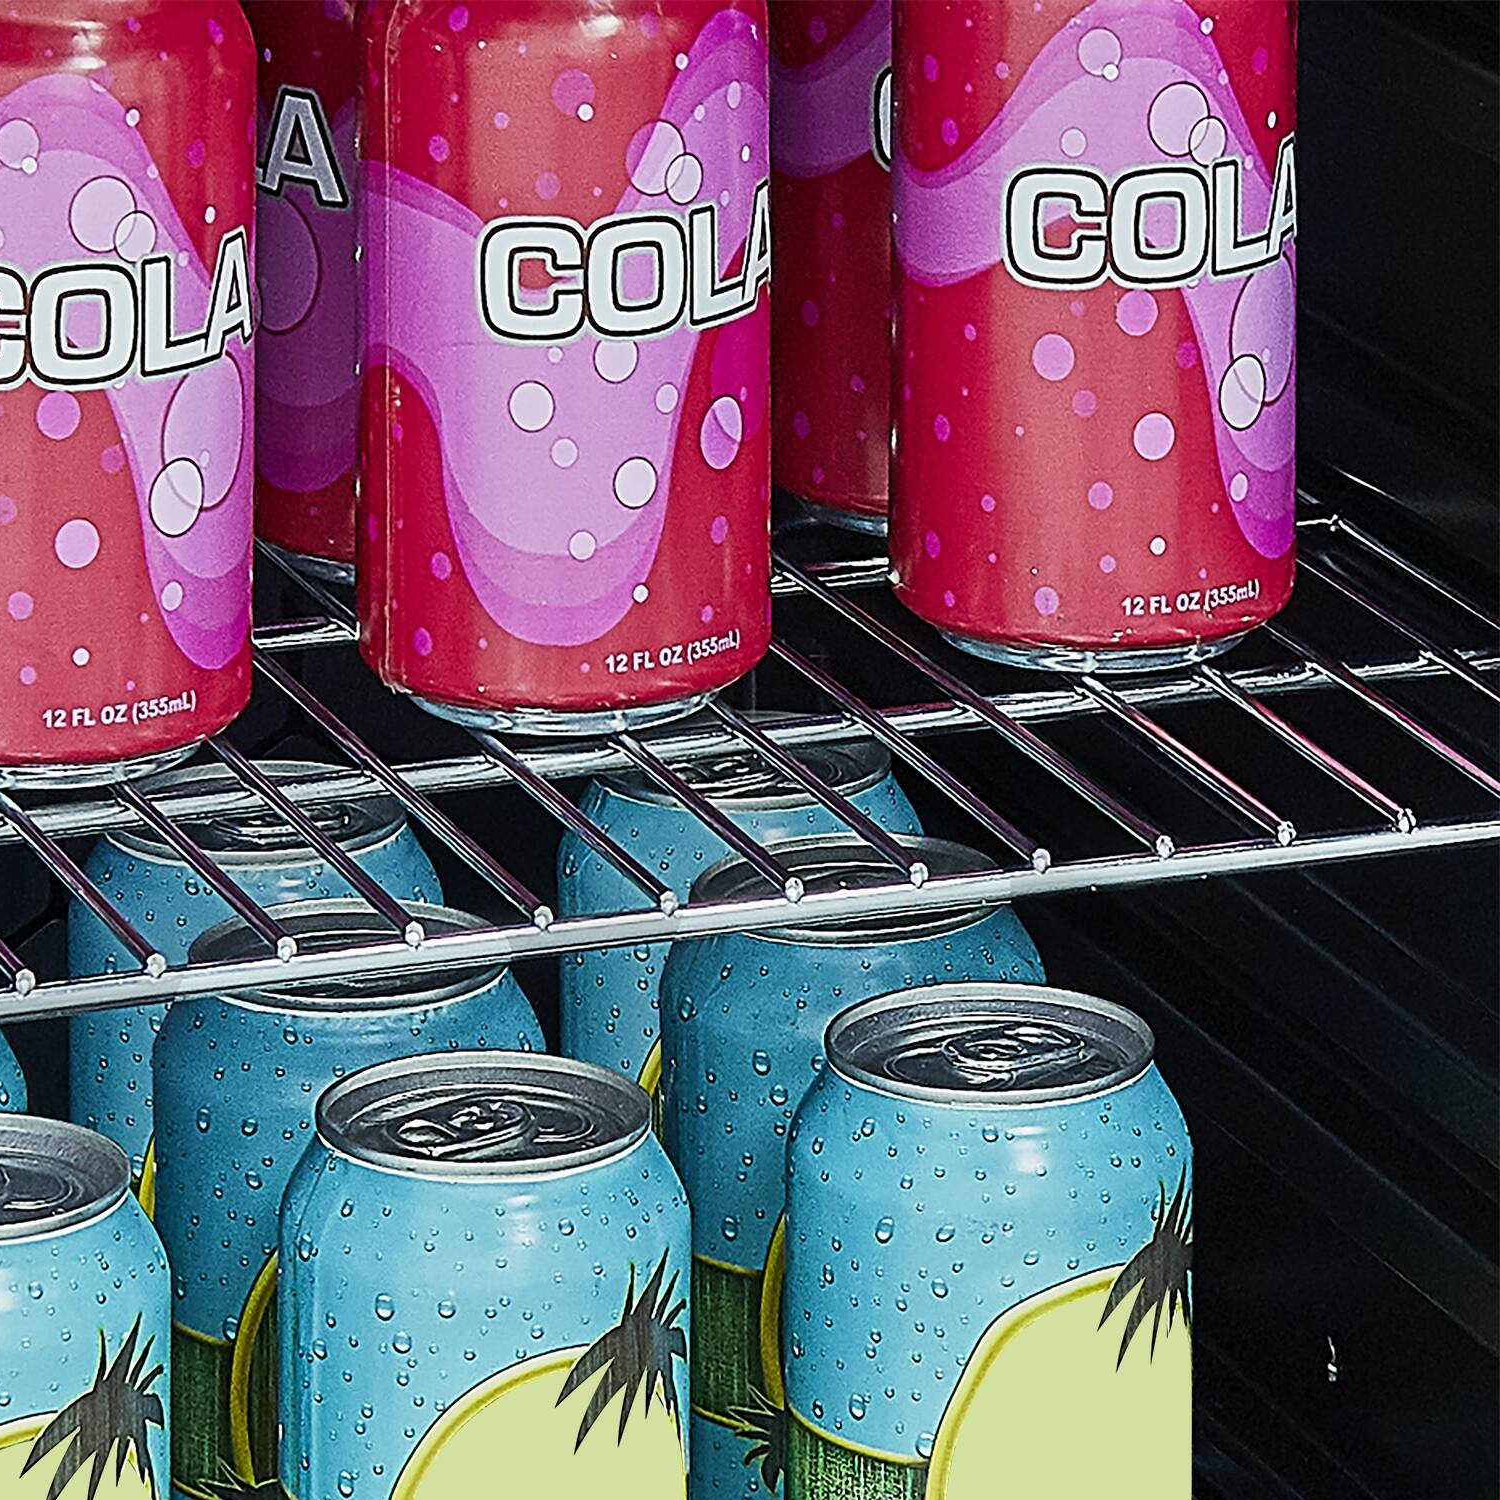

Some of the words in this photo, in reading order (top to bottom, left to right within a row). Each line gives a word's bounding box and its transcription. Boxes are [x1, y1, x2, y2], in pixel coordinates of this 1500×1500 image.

[1006, 136, 1297, 290] COLA
[481, 184, 770, 343] COLA
[1122, 597, 1145, 615] 12
[1149, 595, 1172, 614] FL
[1176, 591, 1200, 611] OZ
[1204, 578, 1259, 613] (355mL)
[605, 654, 628, 673] 12
[633, 651, 655, 670] FL
[659, 645, 683, 667] OZ
[687, 629, 740, 665] (355mL)
[42, 709, 67, 728] 12
[71, 707, 95, 726] FL
[100, 704, 127, 724] OZ
[132, 691, 196, 725] (355mL)
